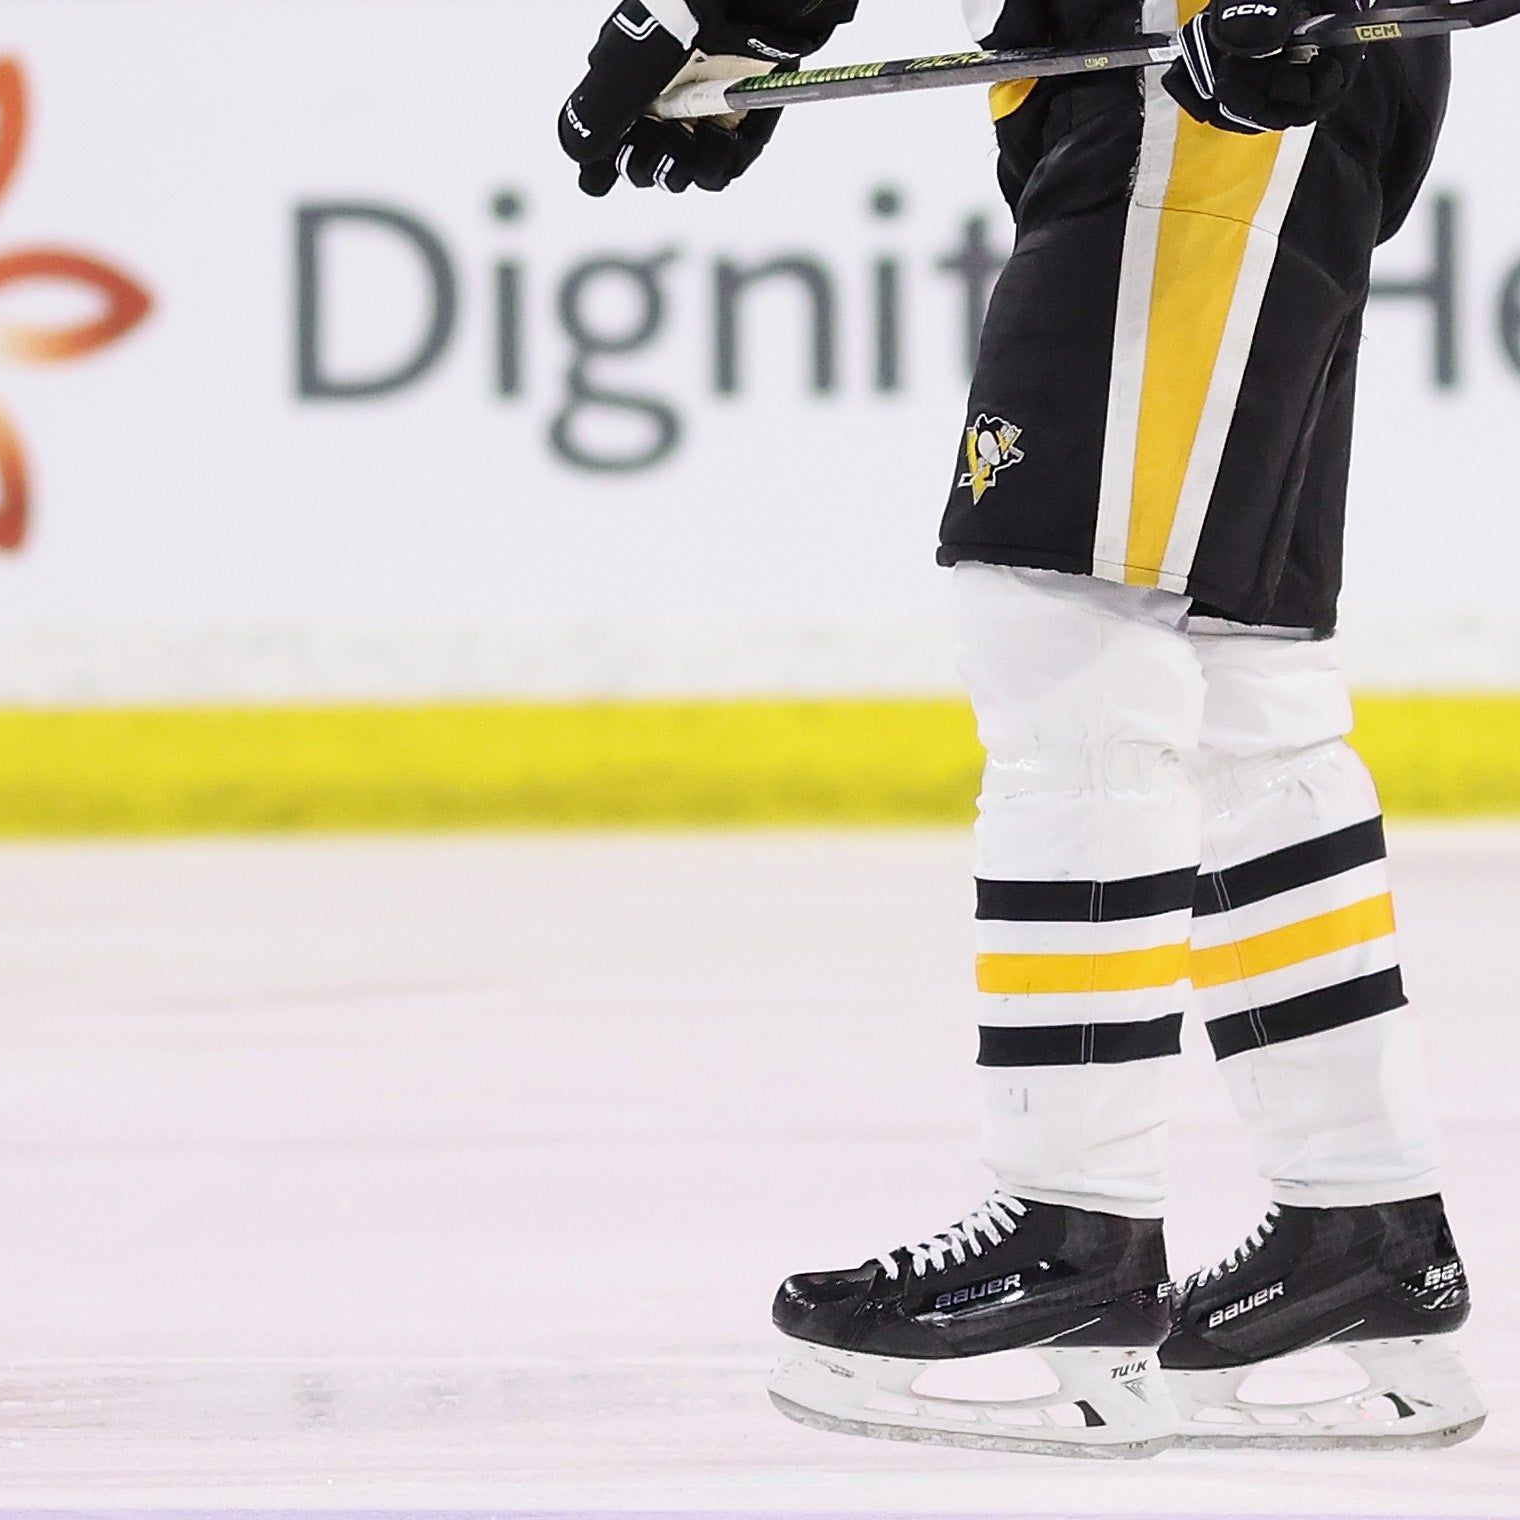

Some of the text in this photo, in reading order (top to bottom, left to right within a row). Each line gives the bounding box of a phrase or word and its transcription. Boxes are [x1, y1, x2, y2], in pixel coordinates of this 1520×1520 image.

[1221, 3, 1278, 21] CCM
[1358, 24, 1399, 40] CCM
[292, 184, 1014, 477] Dignit
[935, 1273, 1021, 1309] BAUER
[1209, 1281, 1284, 1328] BAUER
